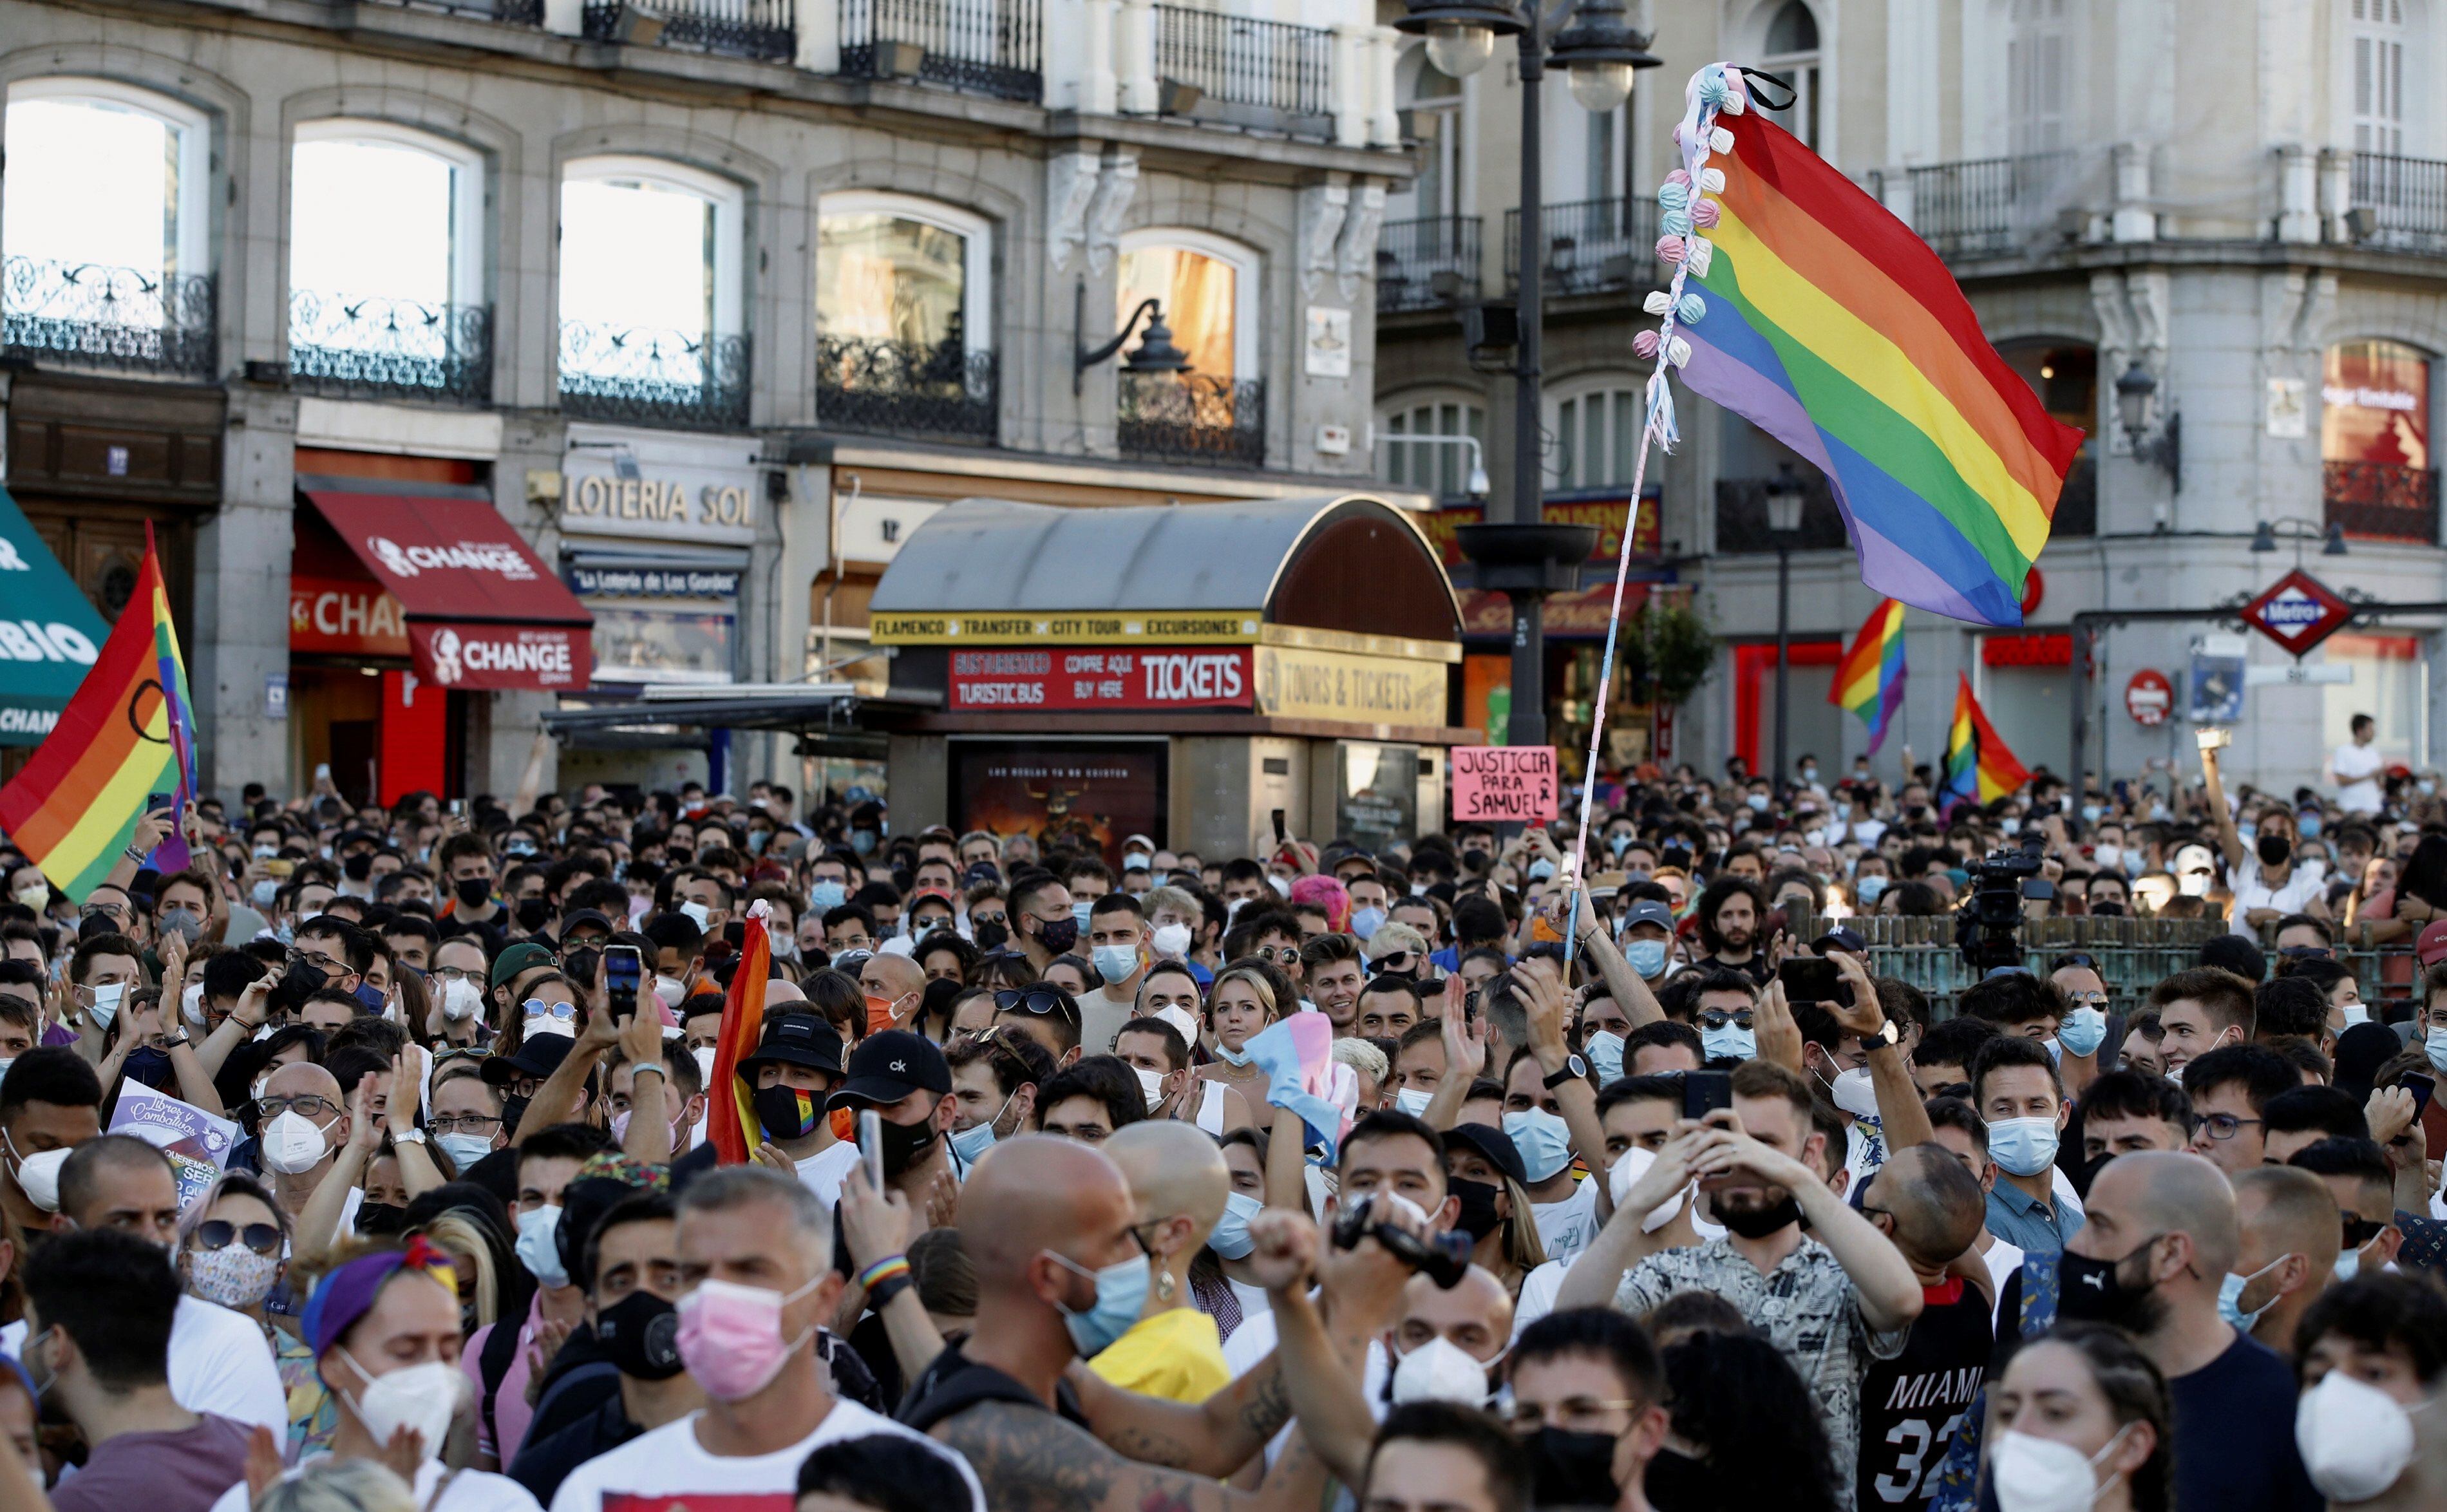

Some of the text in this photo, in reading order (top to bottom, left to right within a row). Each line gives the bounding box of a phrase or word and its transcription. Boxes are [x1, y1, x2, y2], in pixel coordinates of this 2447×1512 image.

[565, 475, 751, 527] LOTERIA SOL
[406, 545, 533, 573] CHANGE
[644, 571, 661, 591] de
[2268, 602, 2316, 622] Metro
[875, 619, 1238, 635] FLAMENCO TRANSFER CITY TOUR EXCURSIONES
[0, 619, 99, 666] BIO
[463, 641, 572, 672] CHANGE
[954, 652, 1051, 675] BUS TURISTICO
[1140, 654, 1242, 700] TICKETS
[1285, 662, 1331, 705] TOURS
[1335, 666, 1347, 706] &
[1353, 668, 1412, 712] TICKETS
[958, 682, 1044, 704] TURISTIC BUS
[1073, 680, 1123, 699] BUY HERE
[1459, 751, 1551, 773] JUSTICIA
[1482, 774, 1524, 791] PARA
[1468, 791, 1544, 815] SAMUEL
[889, 1059, 907, 1073] ck
[131, 1102, 198, 1137] Combativas
[146, 1093, 195, 1122] Libres y
[165, 1149, 215, 1174] QUEREMOS
[184, 1167, 214, 1186] SER
[1884, 1366, 1983, 1410] MIAMI
